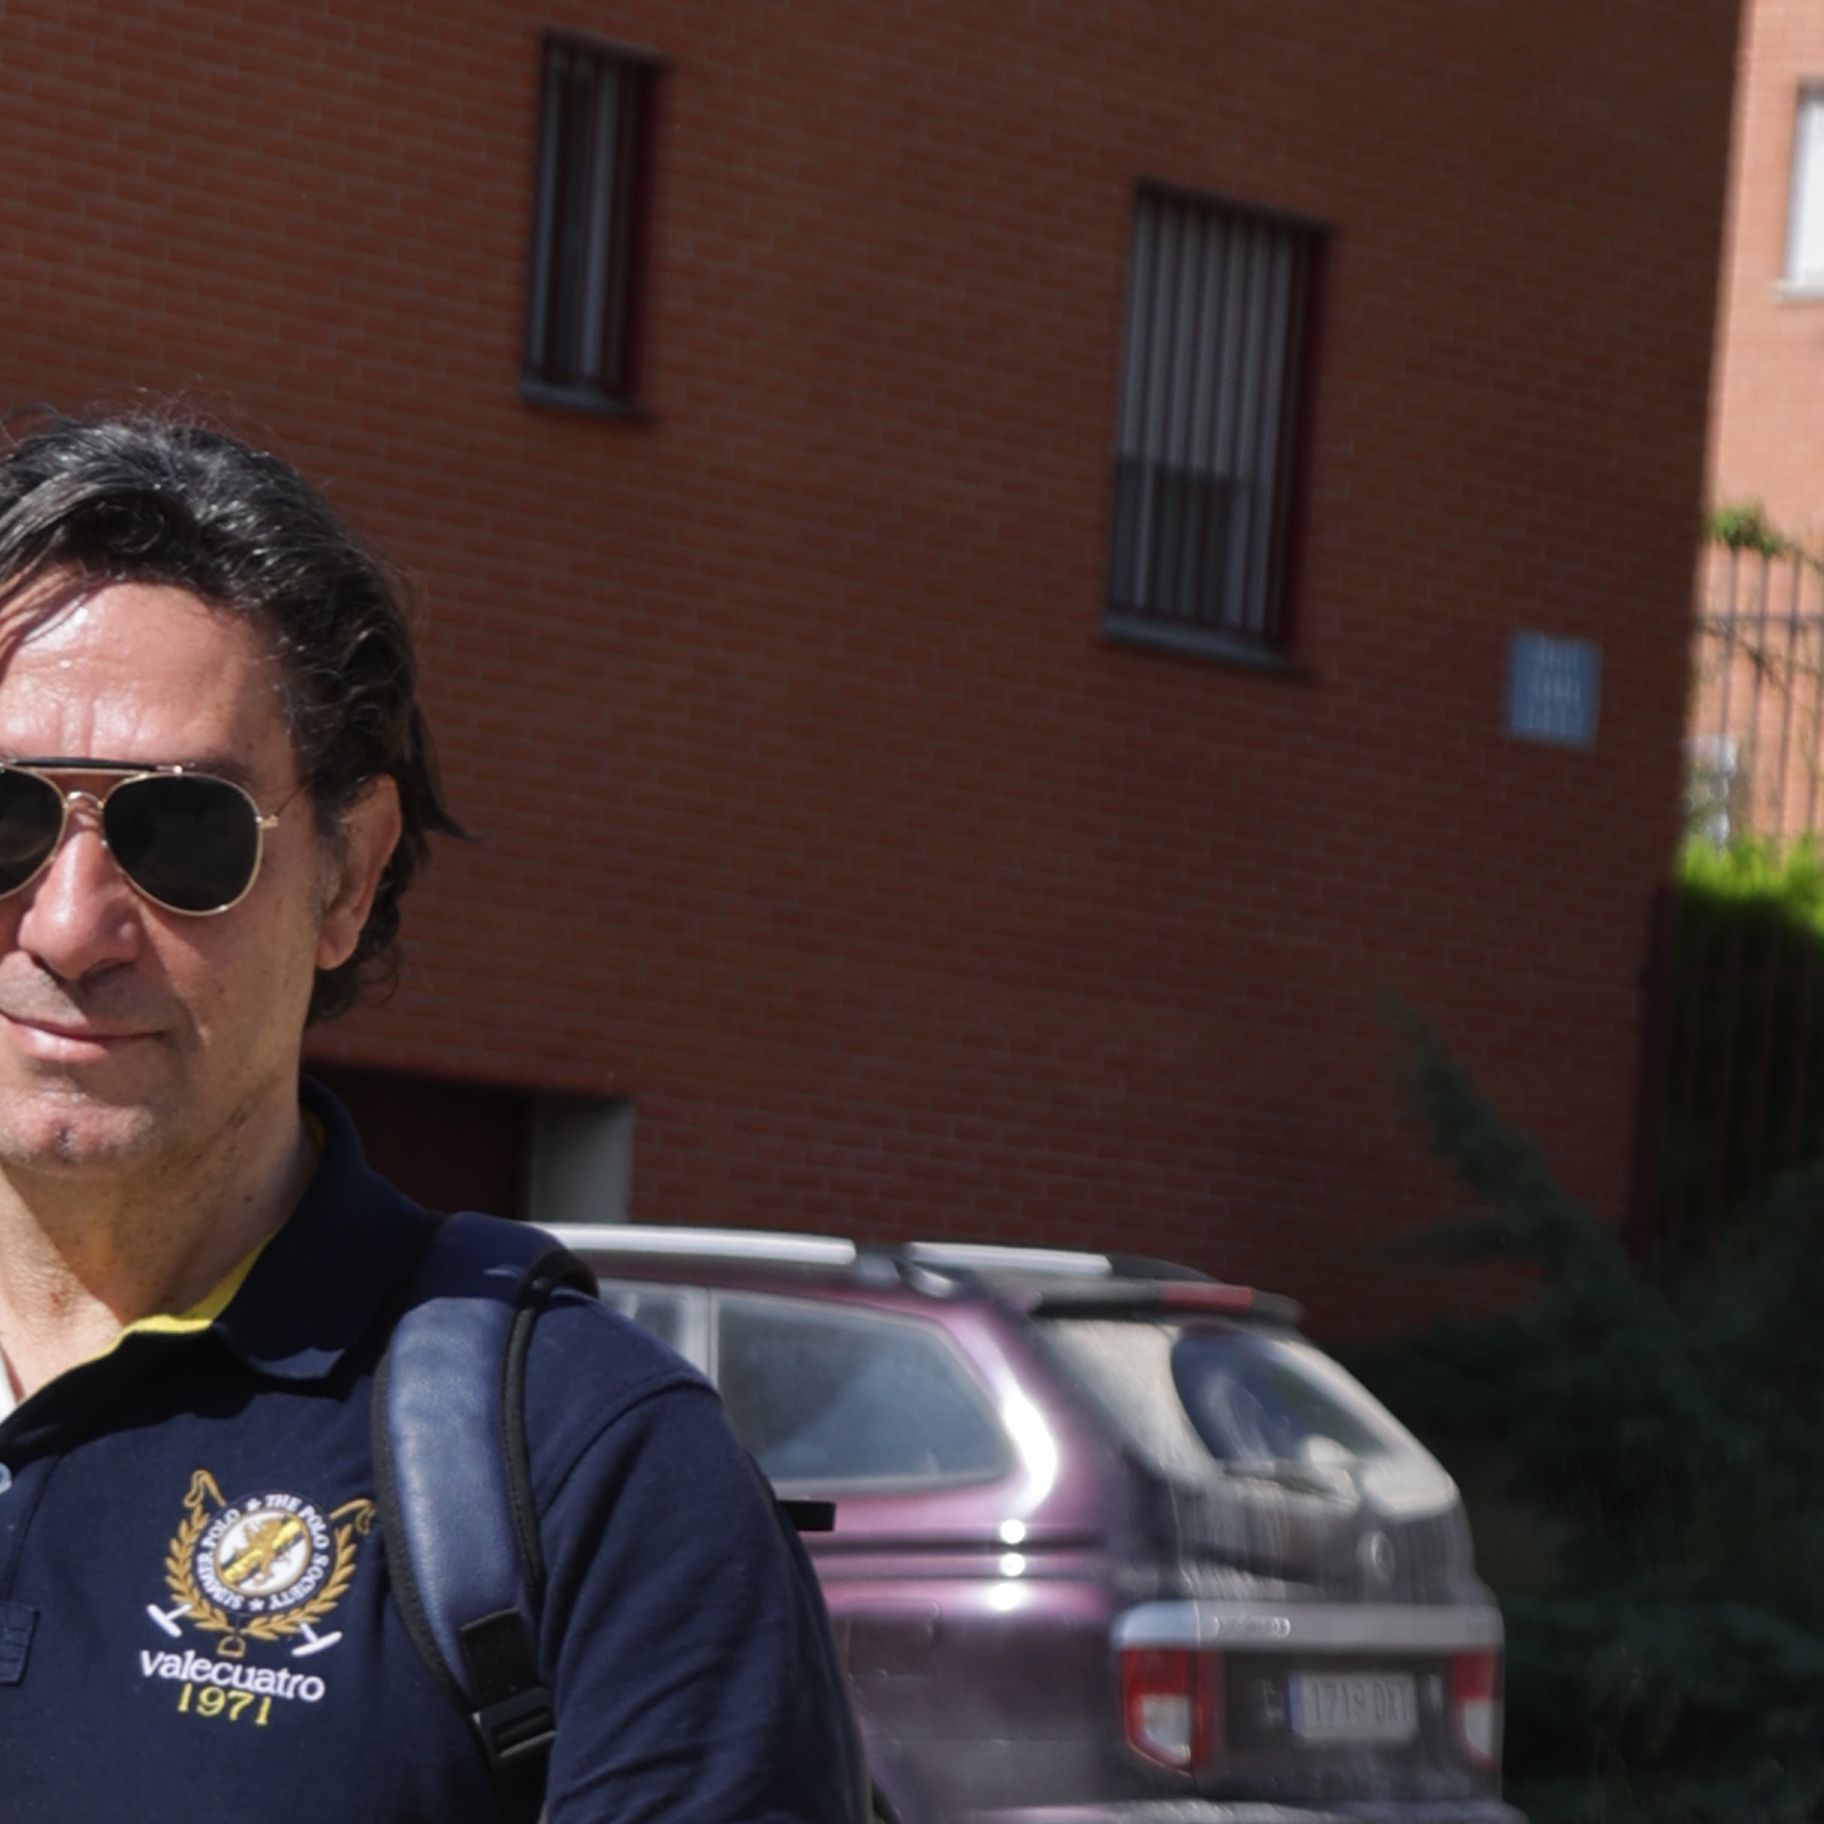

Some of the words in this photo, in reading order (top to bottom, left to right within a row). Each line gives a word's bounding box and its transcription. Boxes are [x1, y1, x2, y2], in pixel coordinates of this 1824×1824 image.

[265, 1493, 302, 1512] THE
[201, 1508, 241, 1548] POLO
[298, 1505, 330, 1549] POLO
[269, 1552, 330, 1610] SOCIETY
[139, 1649, 326, 1703] valecuatro
[177, 1681, 273, 1726] 1971
